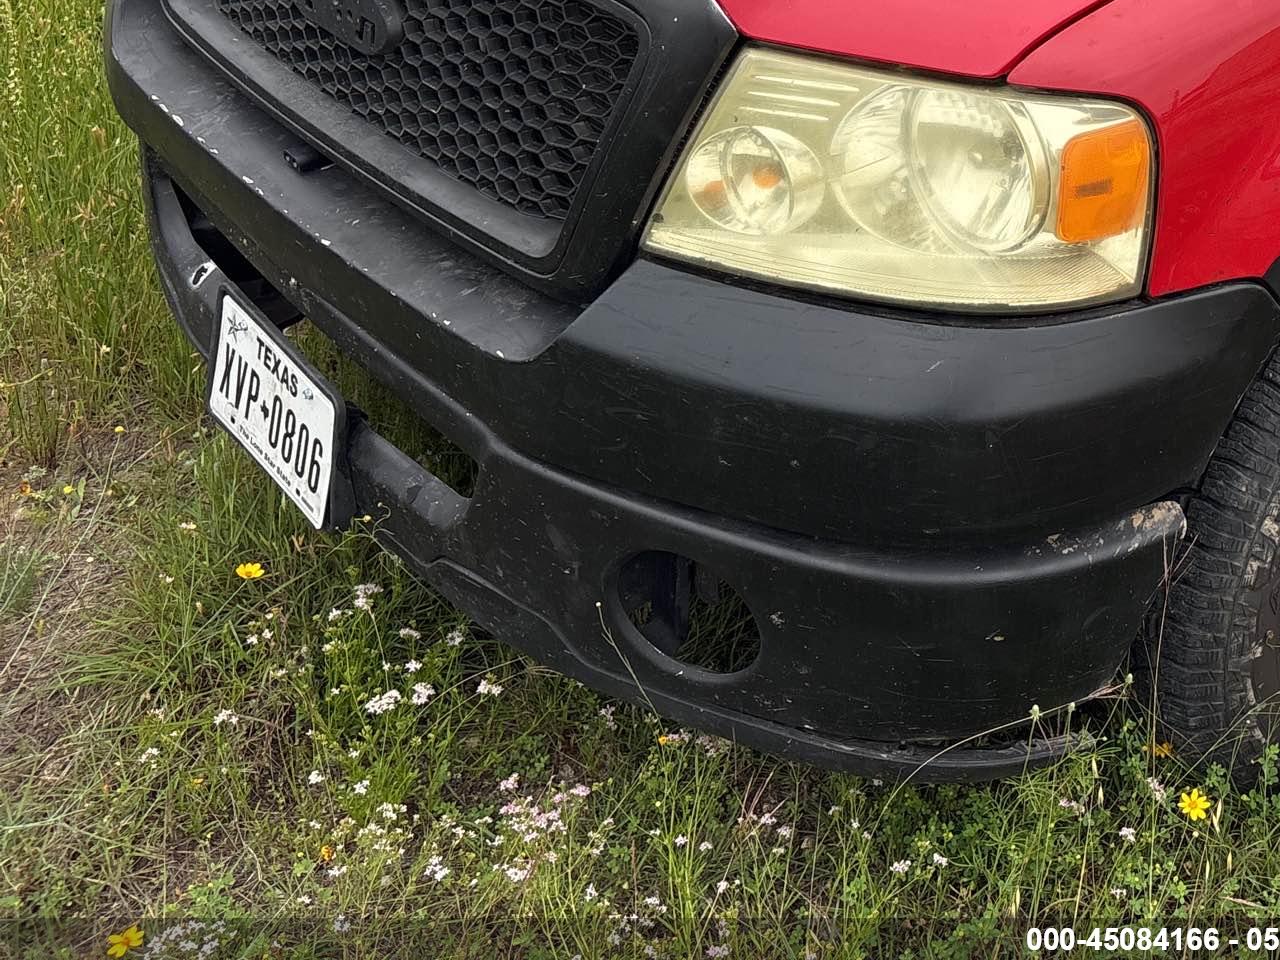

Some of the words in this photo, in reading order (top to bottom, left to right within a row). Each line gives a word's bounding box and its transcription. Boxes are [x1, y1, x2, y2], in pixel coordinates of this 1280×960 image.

[256, 335, 299, 398] TEXAS
[239, 424, 250, 440] The
[249, 436, 264, 456] Lone
[263, 452, 276, 468] Star
[275, 466, 292, 487] State
